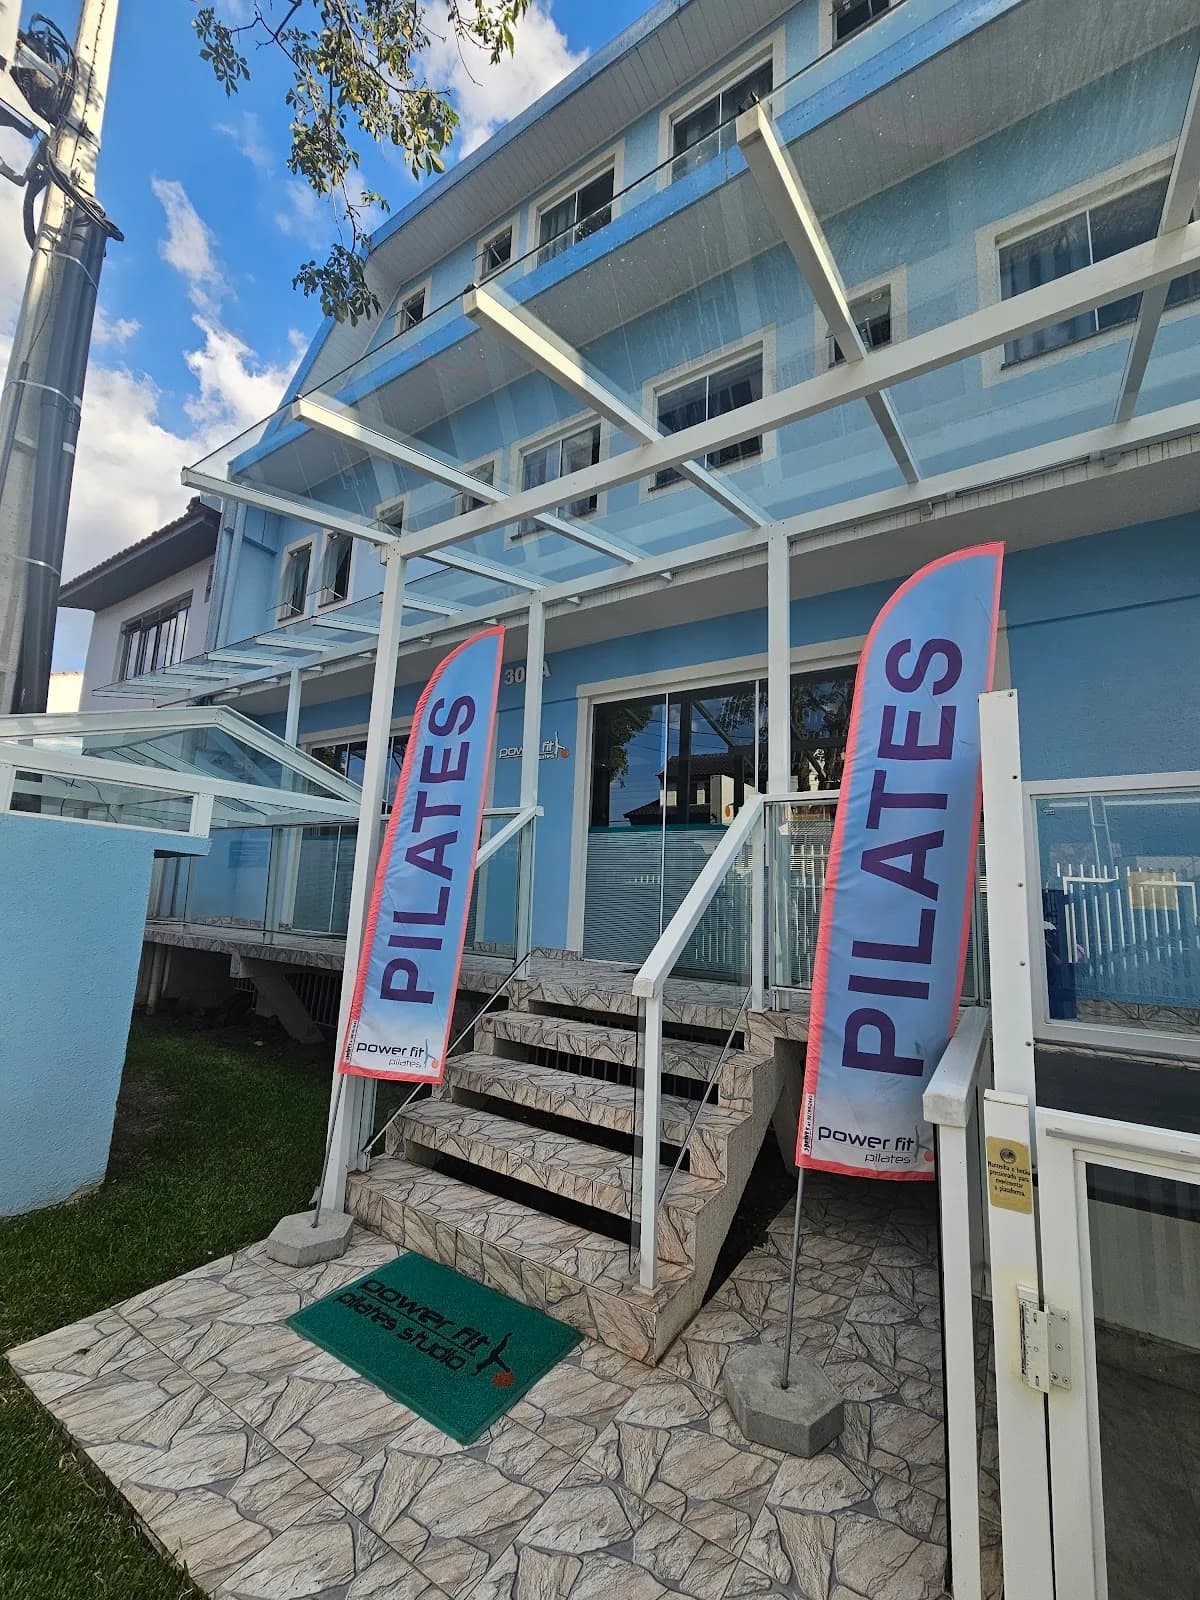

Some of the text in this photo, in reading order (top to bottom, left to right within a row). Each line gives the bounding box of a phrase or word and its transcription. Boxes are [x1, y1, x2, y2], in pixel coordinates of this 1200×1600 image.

[380, 695, 476, 1004] PILATES
[842, 637, 963, 1075] PILATES
[356, 1042, 424, 1058] power fit
[388, 1059, 422, 1068] pilates
[818, 1126, 914, 1151] power fit
[864, 1153, 911, 1164] pilates
[334, 1292, 467, 1370] pilates studio
[358, 1279, 490, 1350] power fit
